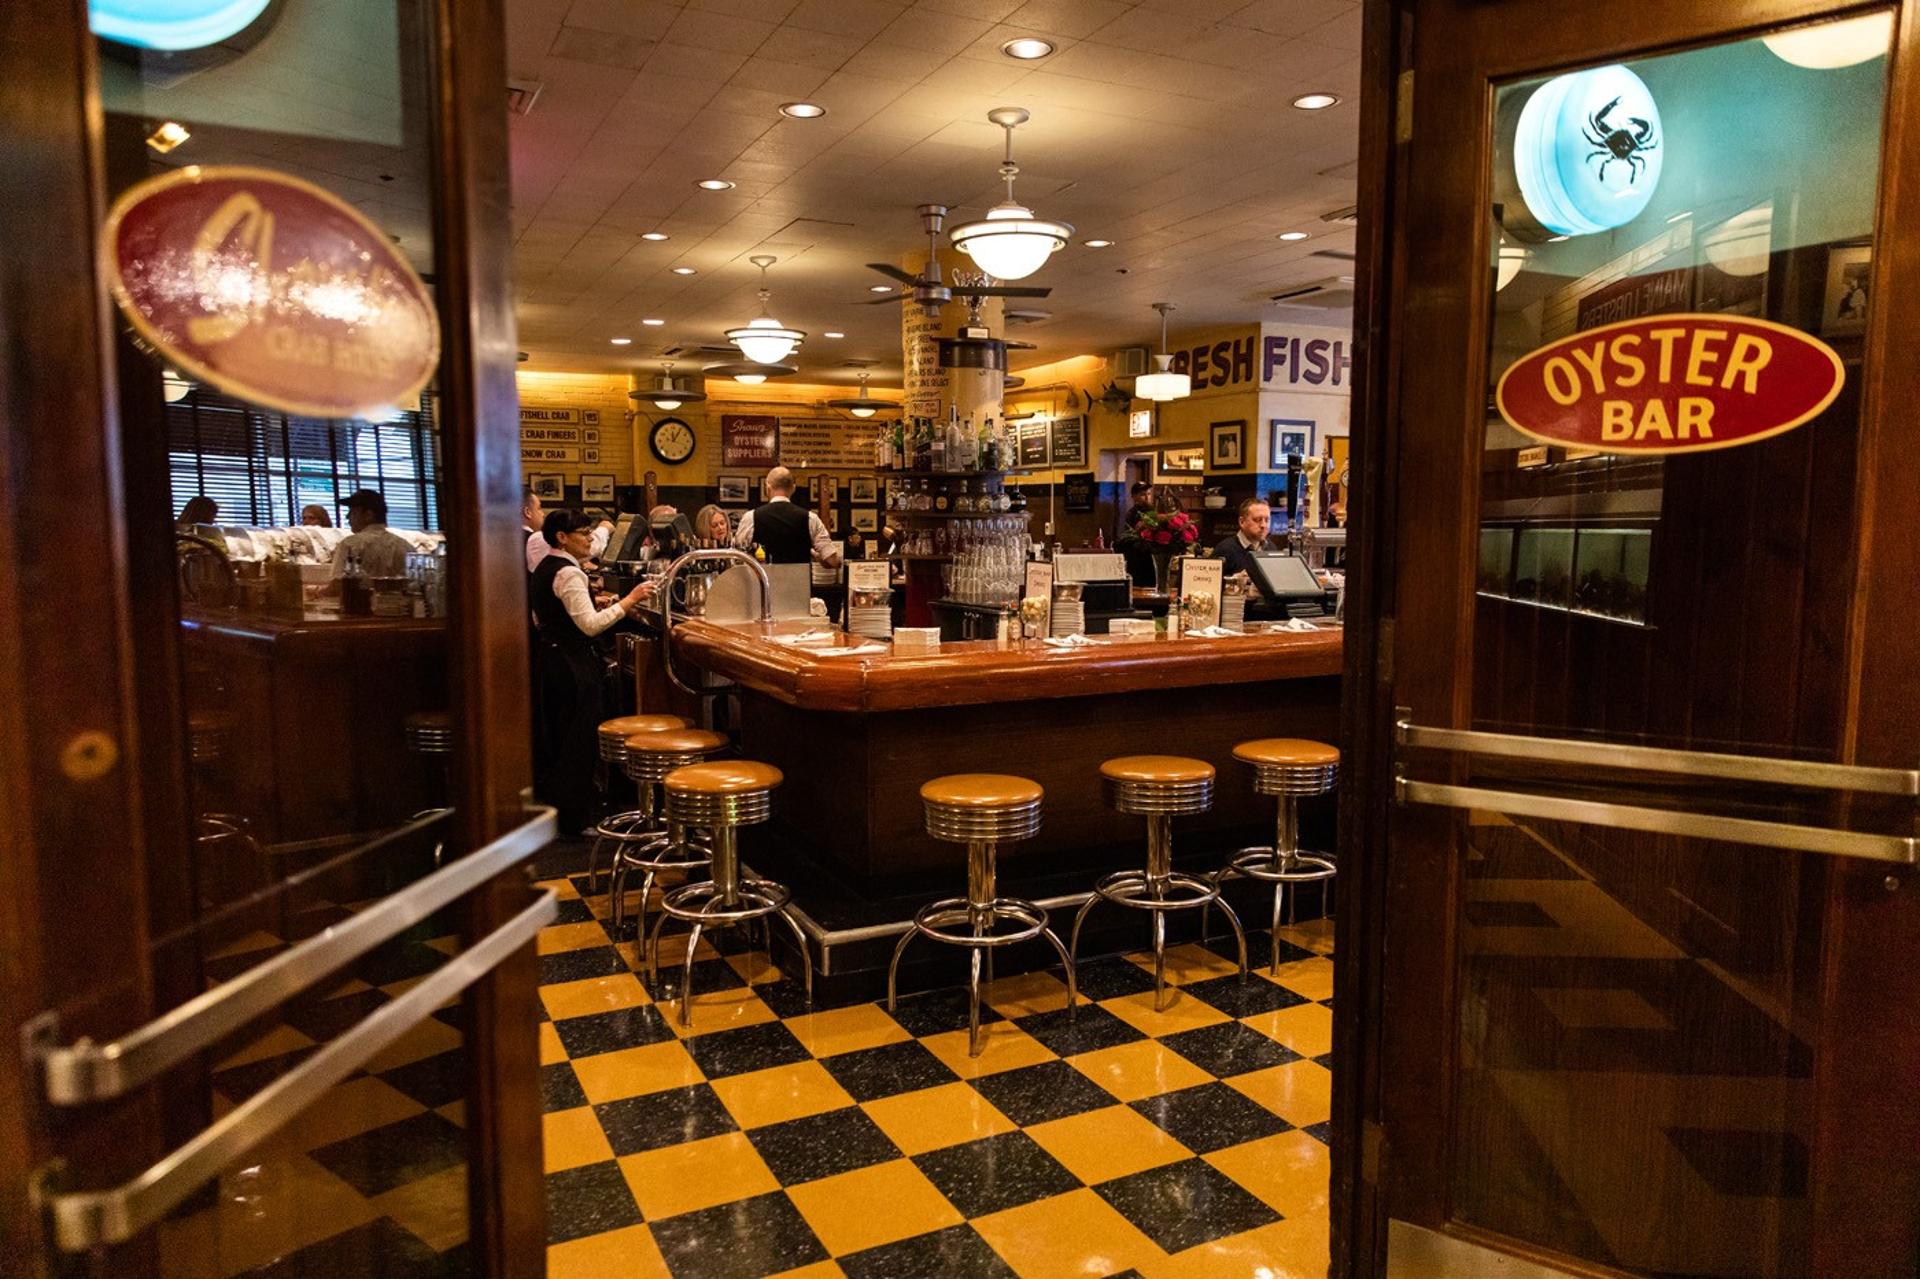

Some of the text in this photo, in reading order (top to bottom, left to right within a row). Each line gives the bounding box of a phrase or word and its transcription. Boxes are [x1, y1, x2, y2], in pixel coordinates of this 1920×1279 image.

[1169, 336, 1254, 390] RESH
[1543, 328, 1773, 406] OYSTER
[551, 411, 570, 421] CRAB
[1601, 396, 1715, 441] BAR
[526, 430, 545, 439] CRAB
[546, 430, 577, 440] FINGERS
[545, 449, 566, 459] CRAB
[727, 448, 772, 458] SUPPLIERS
